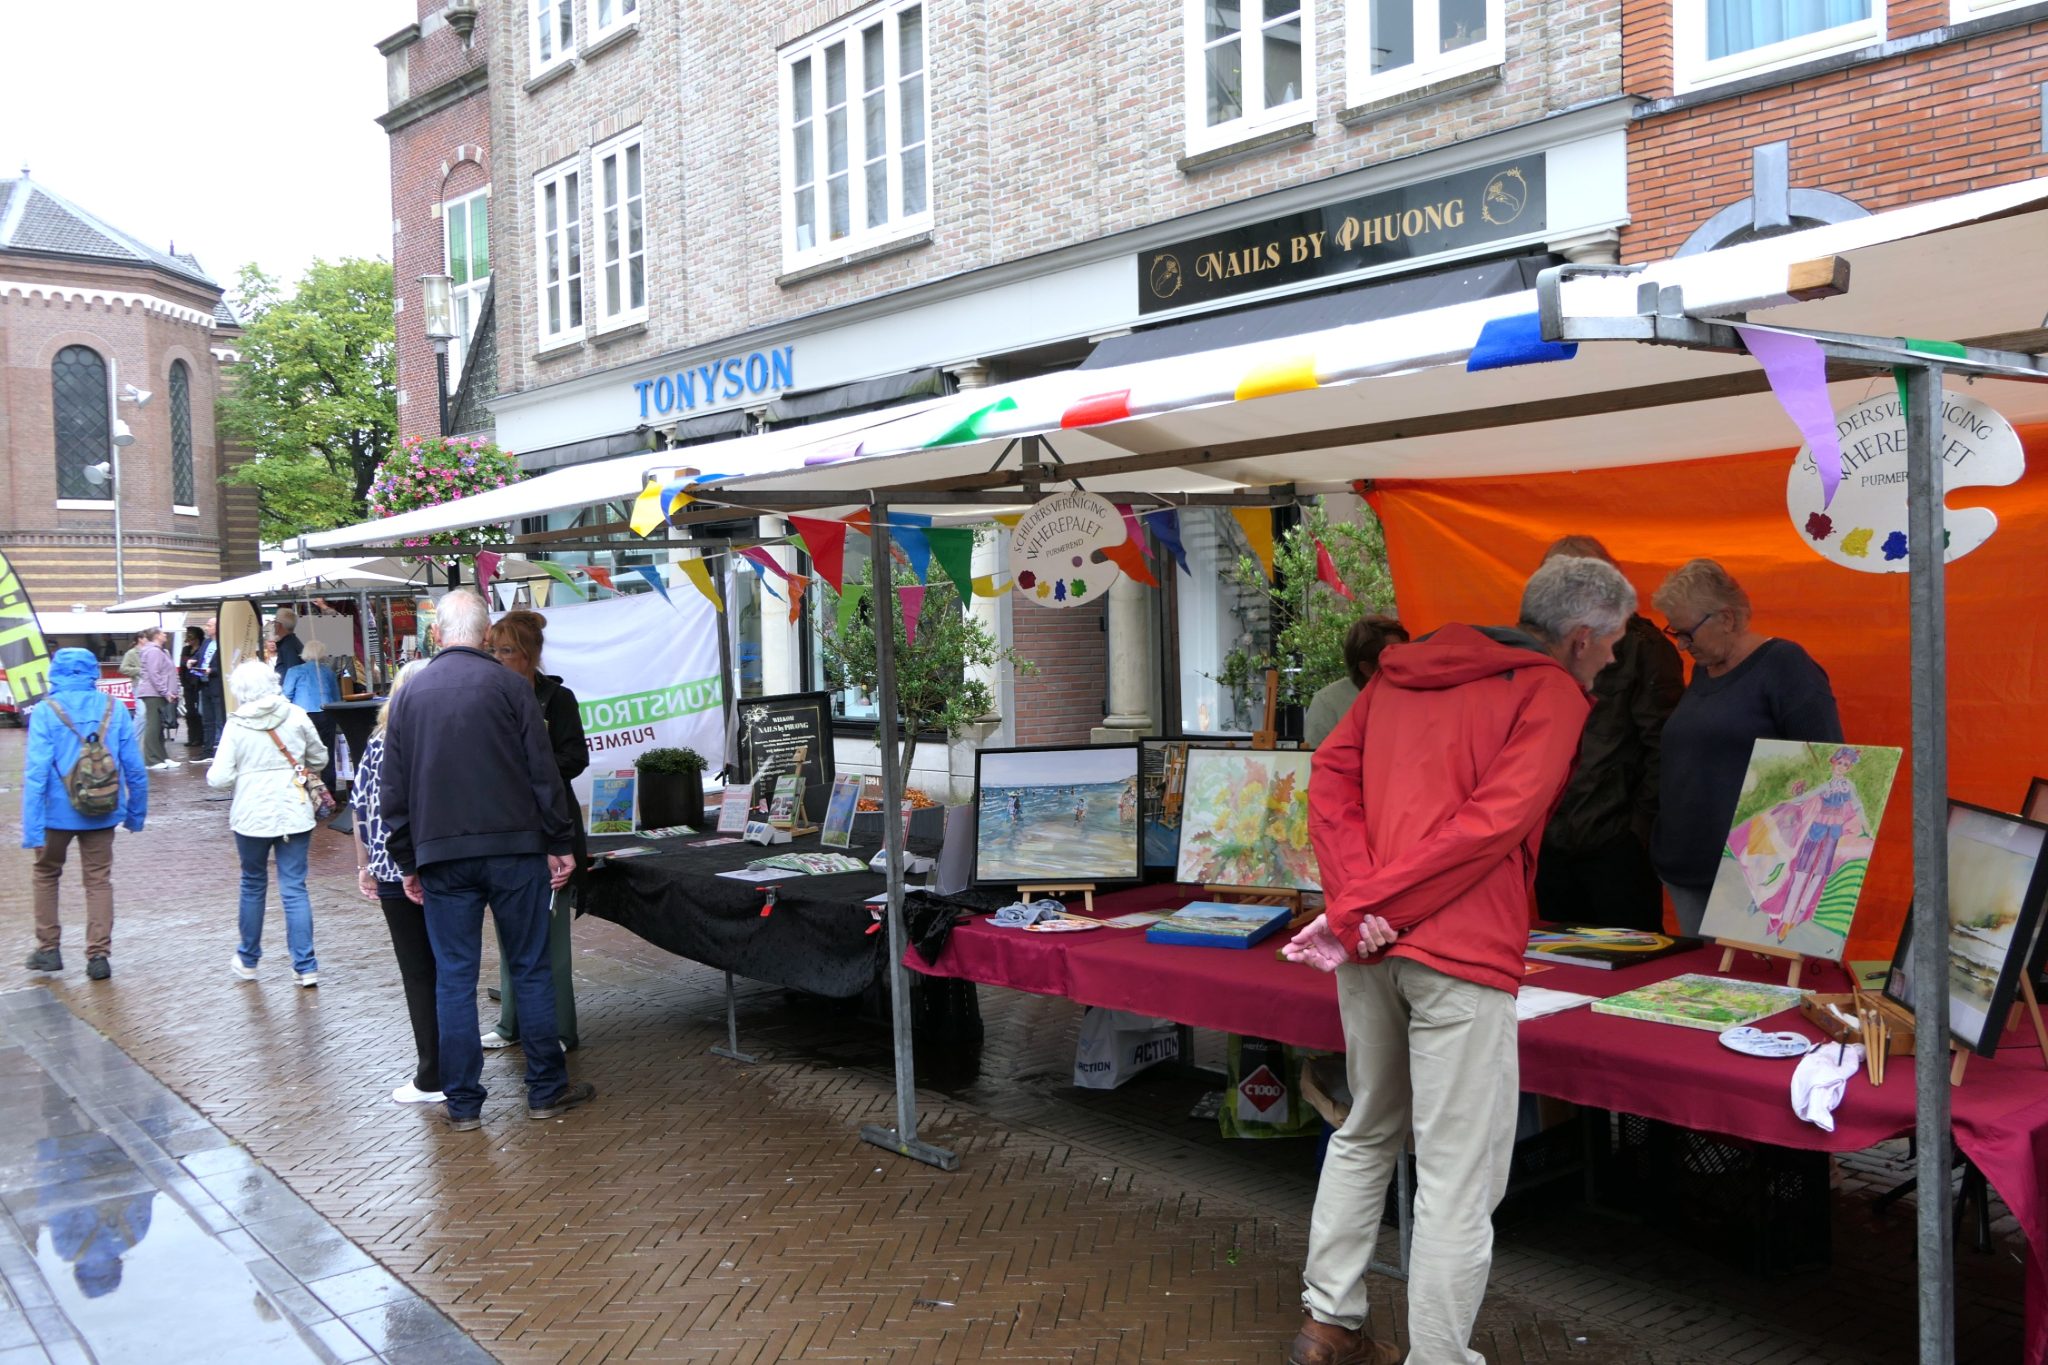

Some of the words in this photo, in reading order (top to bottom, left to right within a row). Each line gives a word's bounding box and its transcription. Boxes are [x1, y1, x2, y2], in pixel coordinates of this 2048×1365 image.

[1290, 230, 1327, 265] BY
[1335, 199, 1465, 252] PHUONG
[633, 344, 794, 418] TONYSON
[1027, 516, 1103, 560] WHEREPALET
[1078, 1061, 1111, 1073] ACTION
[1134, 1035, 1178, 1065] ACTION
[1245, 1083, 1281, 1097] C1000
